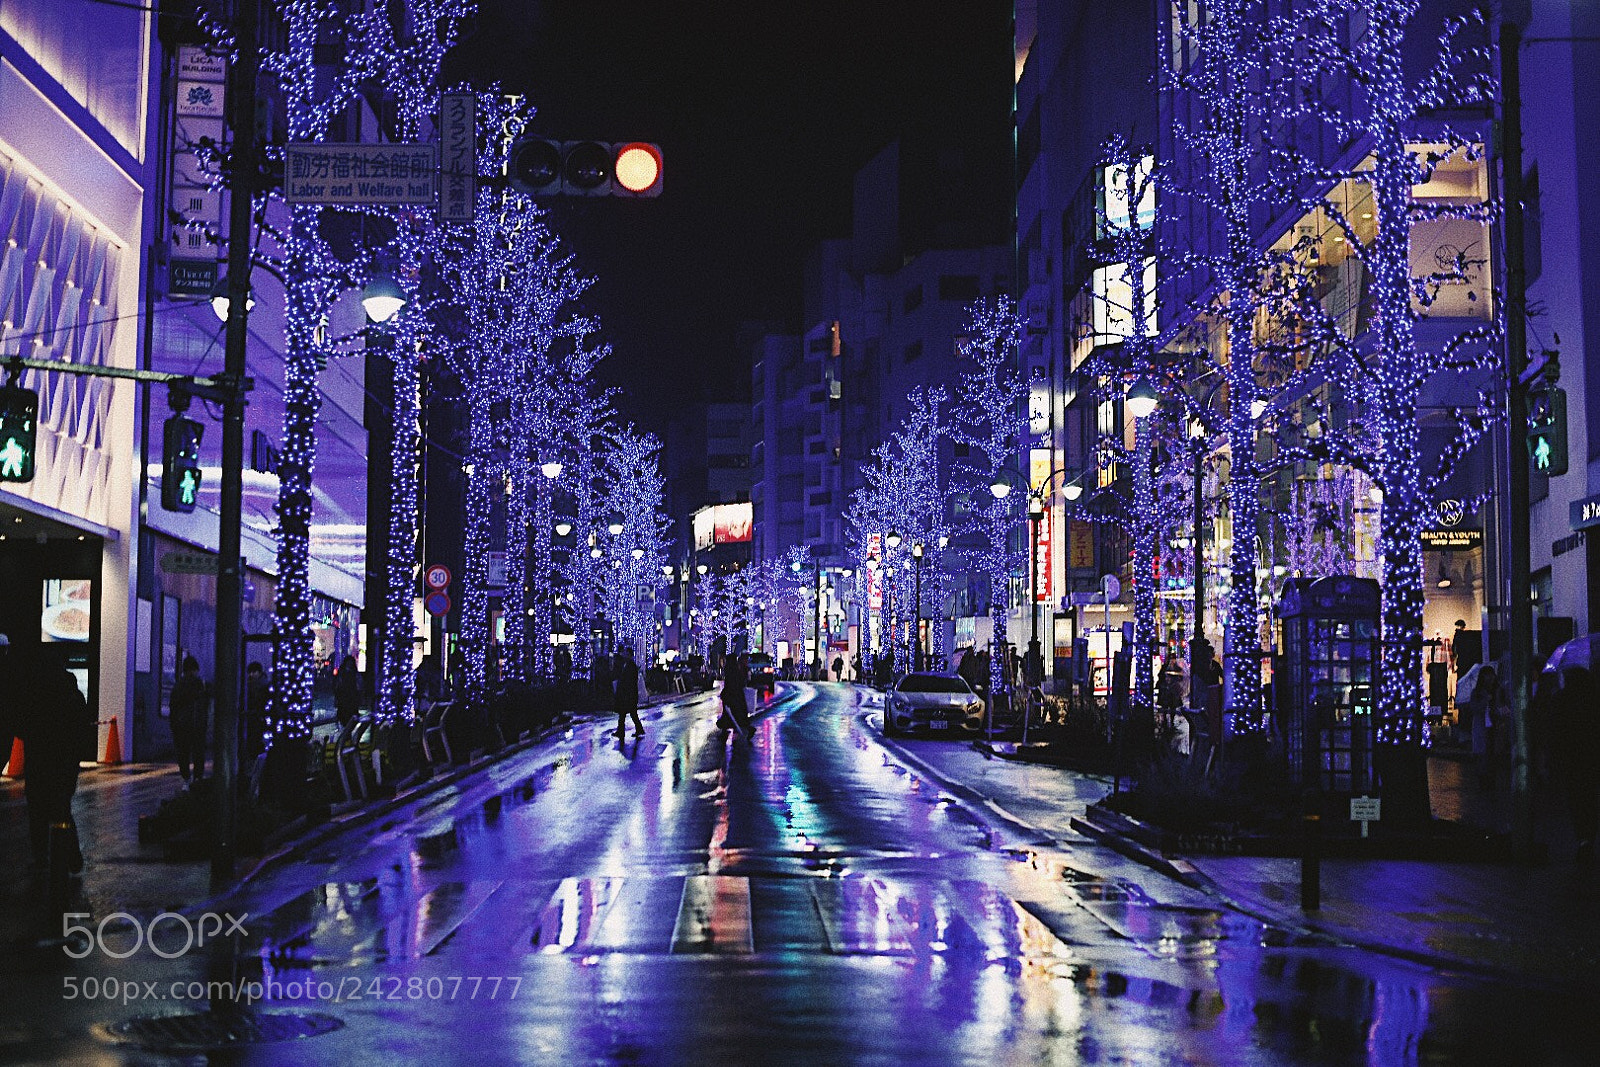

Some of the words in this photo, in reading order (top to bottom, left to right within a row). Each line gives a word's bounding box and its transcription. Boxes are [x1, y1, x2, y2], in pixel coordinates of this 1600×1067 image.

[181, 65, 223, 74] BUILDING
[292, 152, 430, 179] 勤労福祉会館前
[291, 183, 325, 197] Labor
[331, 183, 352, 197] and
[358, 182, 403, 197] Welfare
[408, 182, 430, 196] hall
[431, 572, 447, 584] 30
[637, 585, 651, 601] P
